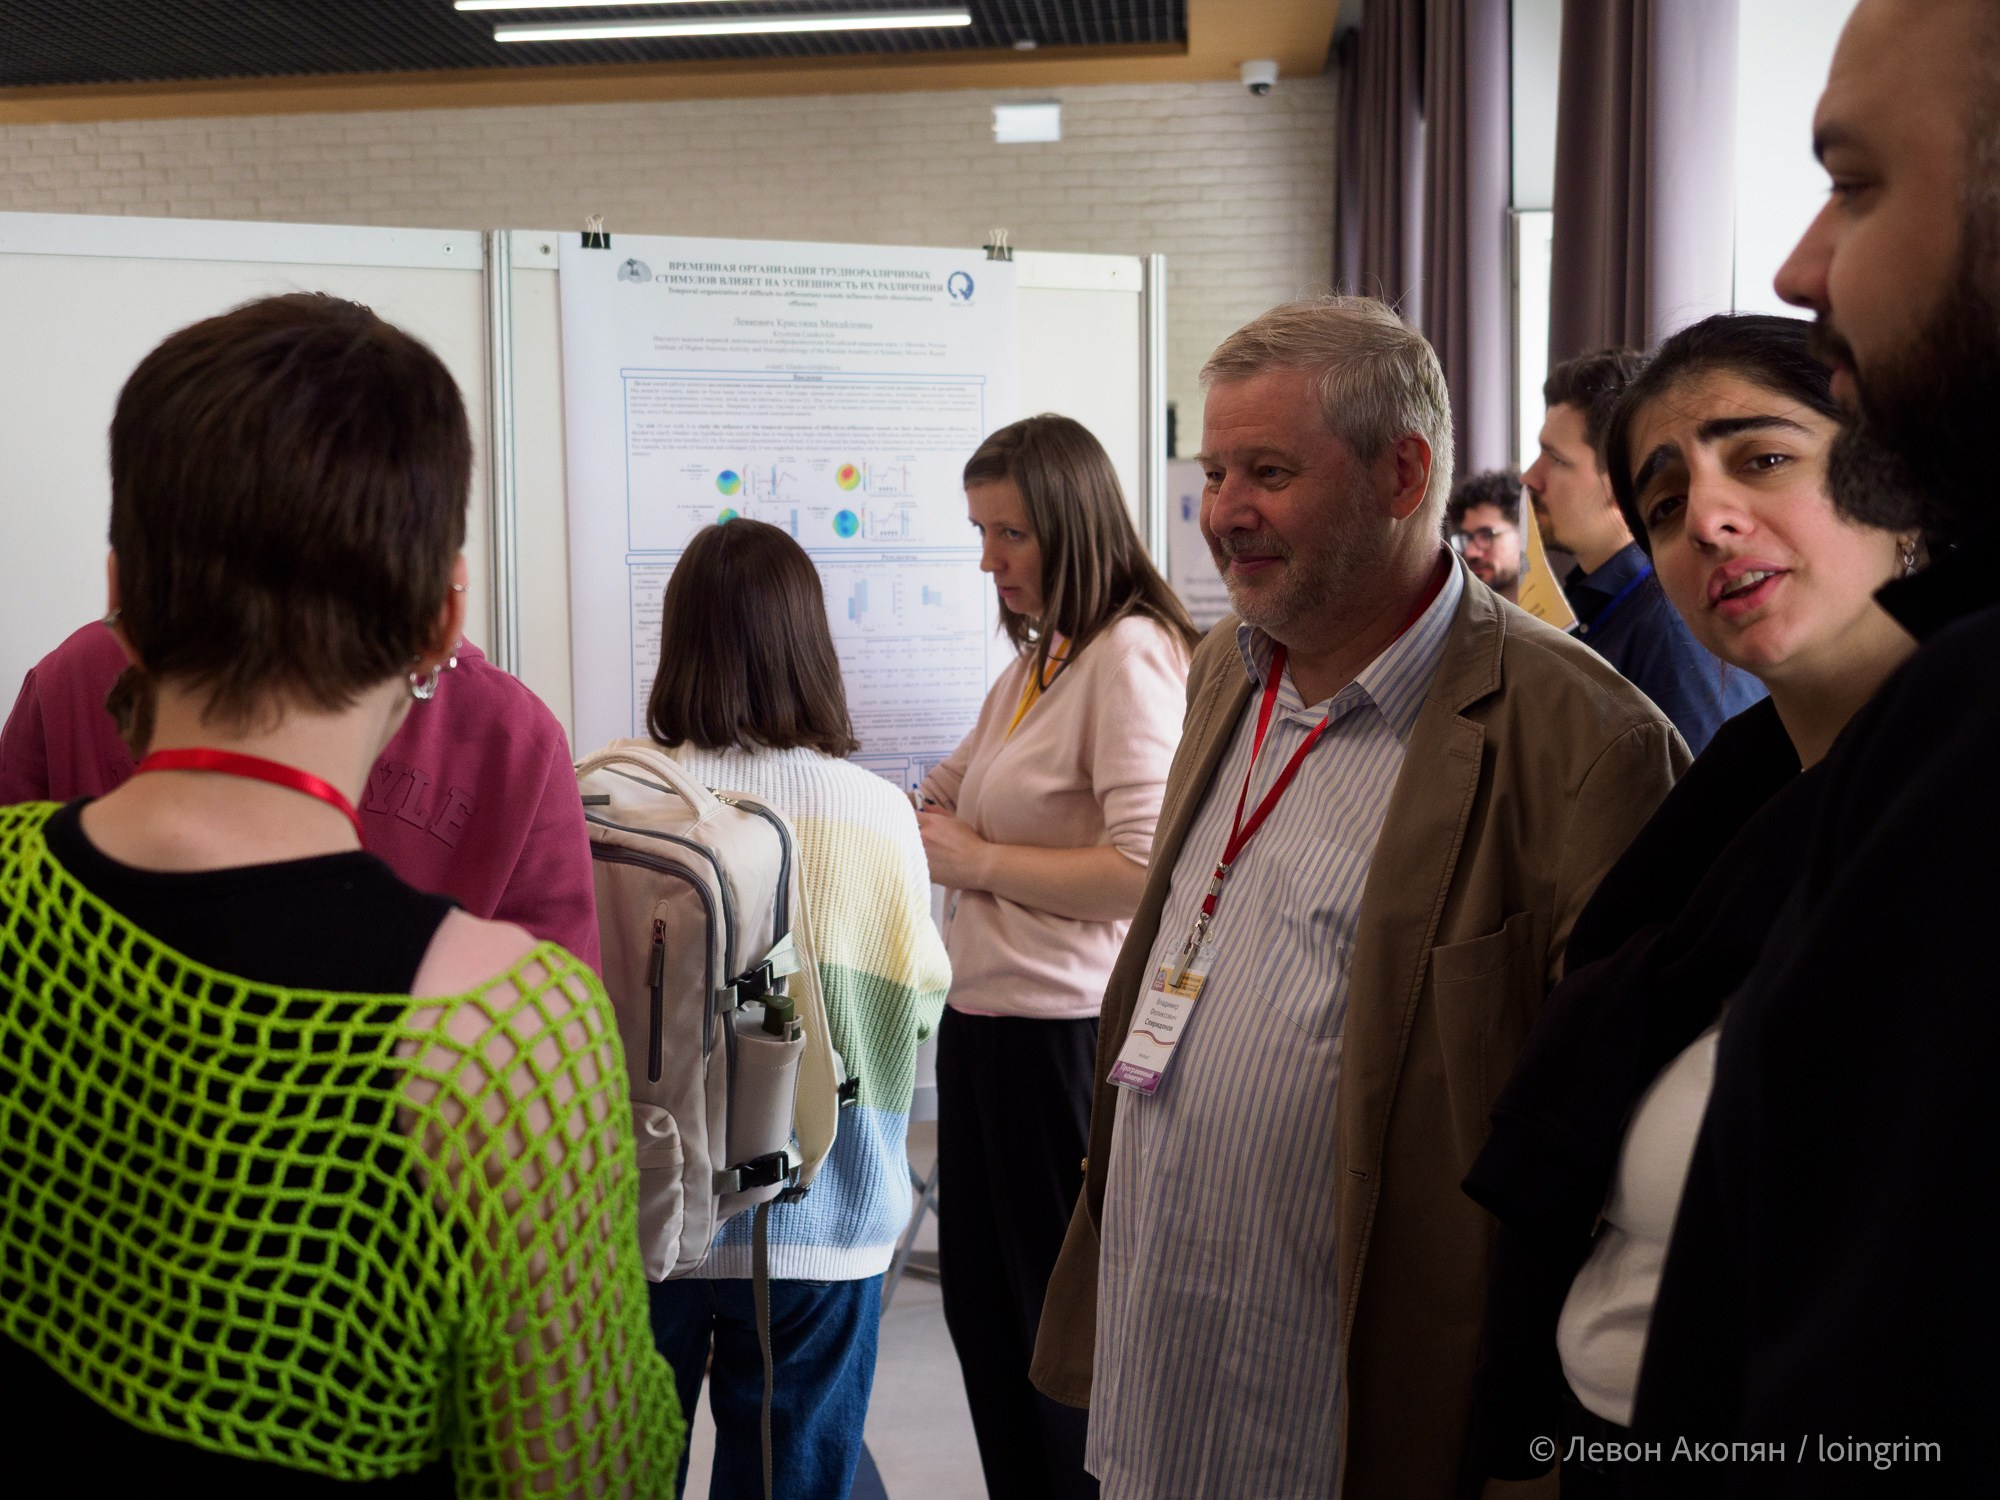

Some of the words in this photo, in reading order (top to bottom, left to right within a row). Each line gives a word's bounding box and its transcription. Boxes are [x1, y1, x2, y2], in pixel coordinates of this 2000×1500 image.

[669, 262, 736, 272] ВРЕМЕННАЯ
[739, 264, 816, 275] ОРГАНИЗАЦИЯ
[820, 267, 930, 279] ТРУДНОРАЗЛИЧИМЫХ
[656, 275, 716, 284] СТИМУЛОВ
[720, 277, 760, 286] ВЛИЯЕТ
[765, 278, 779, 286] НА
[783, 279, 857, 289] УСПЕШНОСТЬ
[878, 283, 943, 292] РАЗЛИЧЕНИЯ
[1145, 1018, 1173, 1031] Спиридонов
